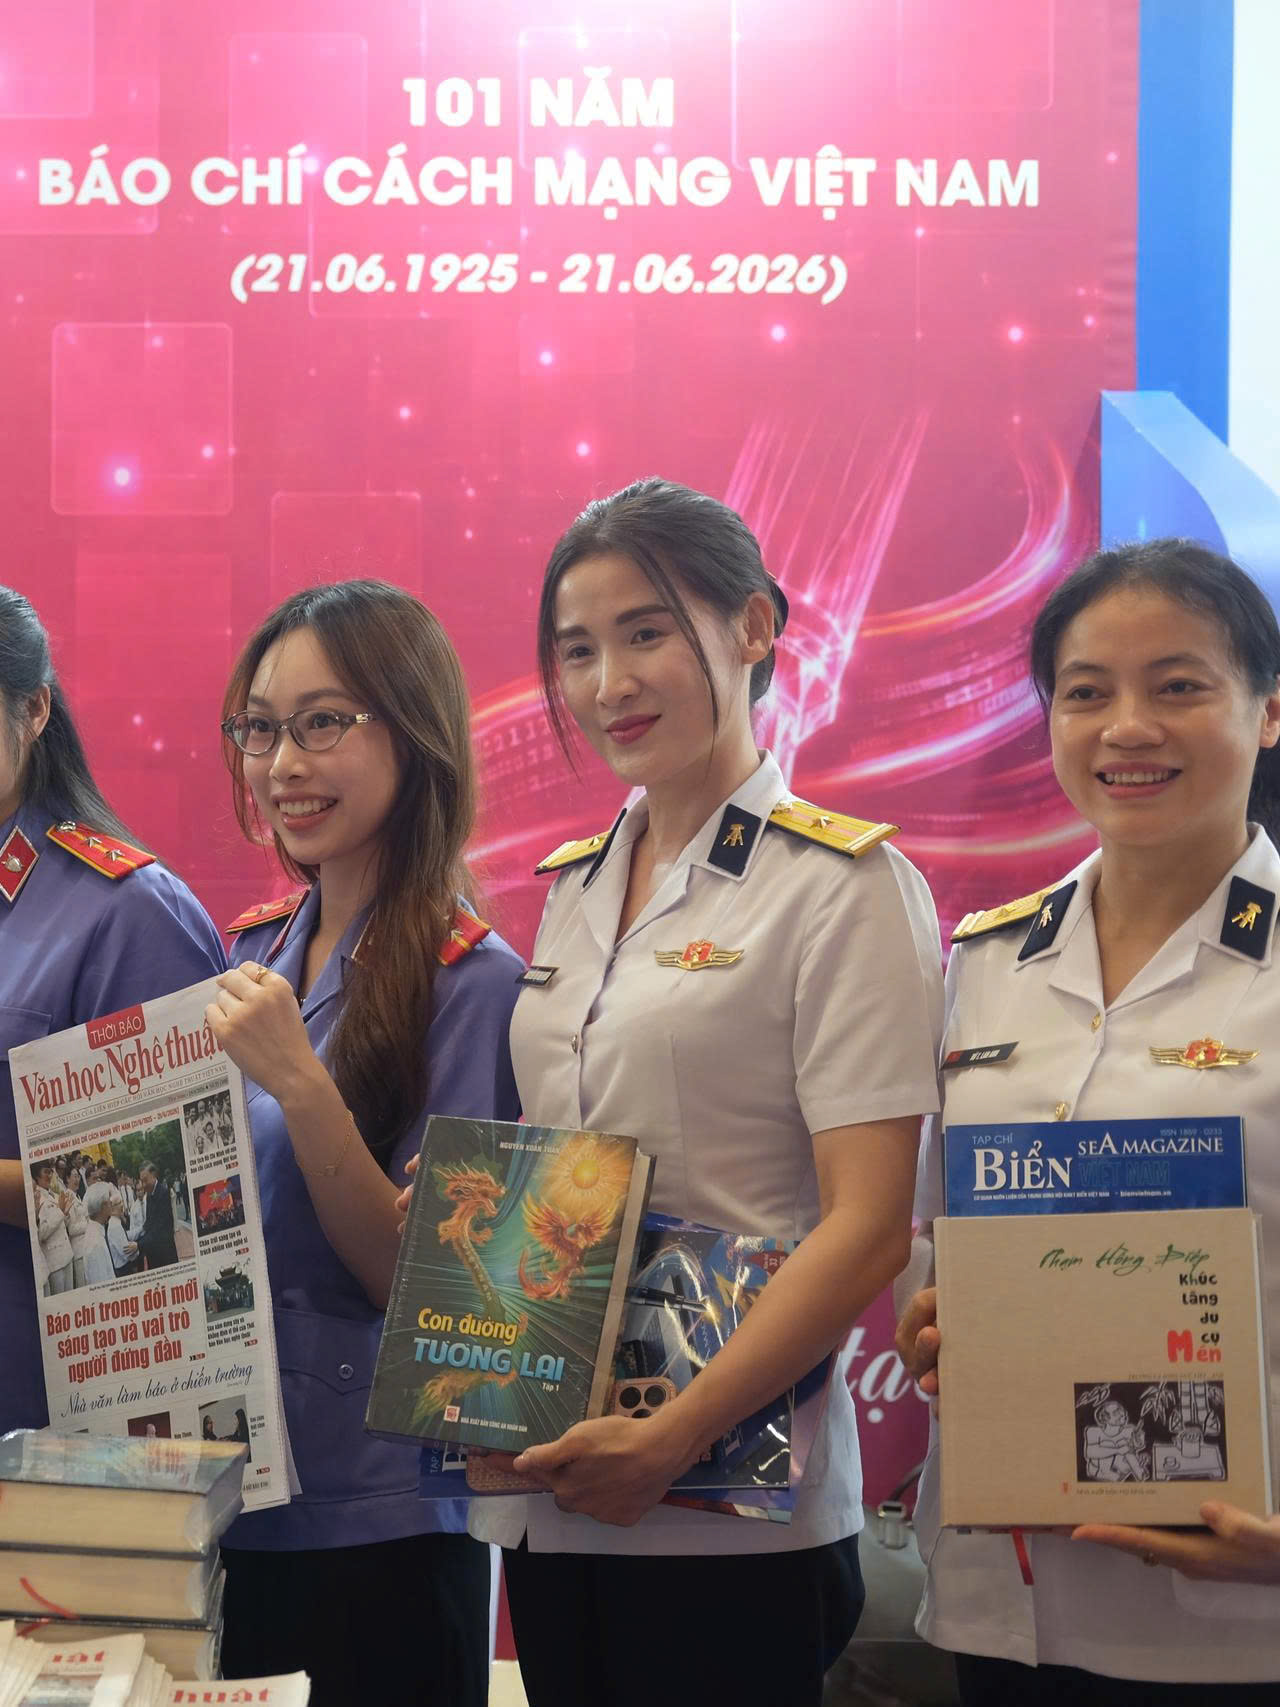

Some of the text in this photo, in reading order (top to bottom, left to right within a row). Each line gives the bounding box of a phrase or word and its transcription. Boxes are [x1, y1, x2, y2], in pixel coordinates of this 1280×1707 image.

[402, 65, 674, 127] 101 NĂM
[38, 142, 1039, 221] BÁO CHÍ CÁCH MẠNG VIỆT NAM
[230, 253, 519, 303] (21.06.1925
[559, 253, 847, 305] 21.06.2026)
[89, 1014, 142, 1044] THỜI BÁO
[20, 1071, 66, 1115] Văn
[64, 1061, 107, 1102] học
[105, 1036, 164, 1096] Nghệ
[972, 1132, 1013, 1146] TẠP CHÍ
[1122, 1137, 1224, 1155] MAGAZINE
[1179, 1272, 1218, 1286] Khúc
[46, 1311, 72, 1337] Báo
[74, 1301, 96, 1331] chí
[99, 1295, 140, 1325] trong
[143, 1282, 168, 1309] đổi
[171, 1277, 200, 1305] mới
[417, 1307, 518, 1346] Con đường
[1200, 1312, 1219, 1324] du
[57, 1306, 191, 1361] sáng tạo và vai trò
[1201, 1332, 1220, 1346] cụ
[67, 1335, 184, 1384] người đứng đầu
[413, 1336, 565, 1382] TƯƠNG LAI
[60, 1390, 88, 1418] Nhà
[90, 1394, 114, 1412] văn
[116, 1384, 144, 1406] làm
[144, 1376, 168, 1399] báo
[180, 1366, 212, 1392] chiến
[214, 1362, 254, 1387] trường
